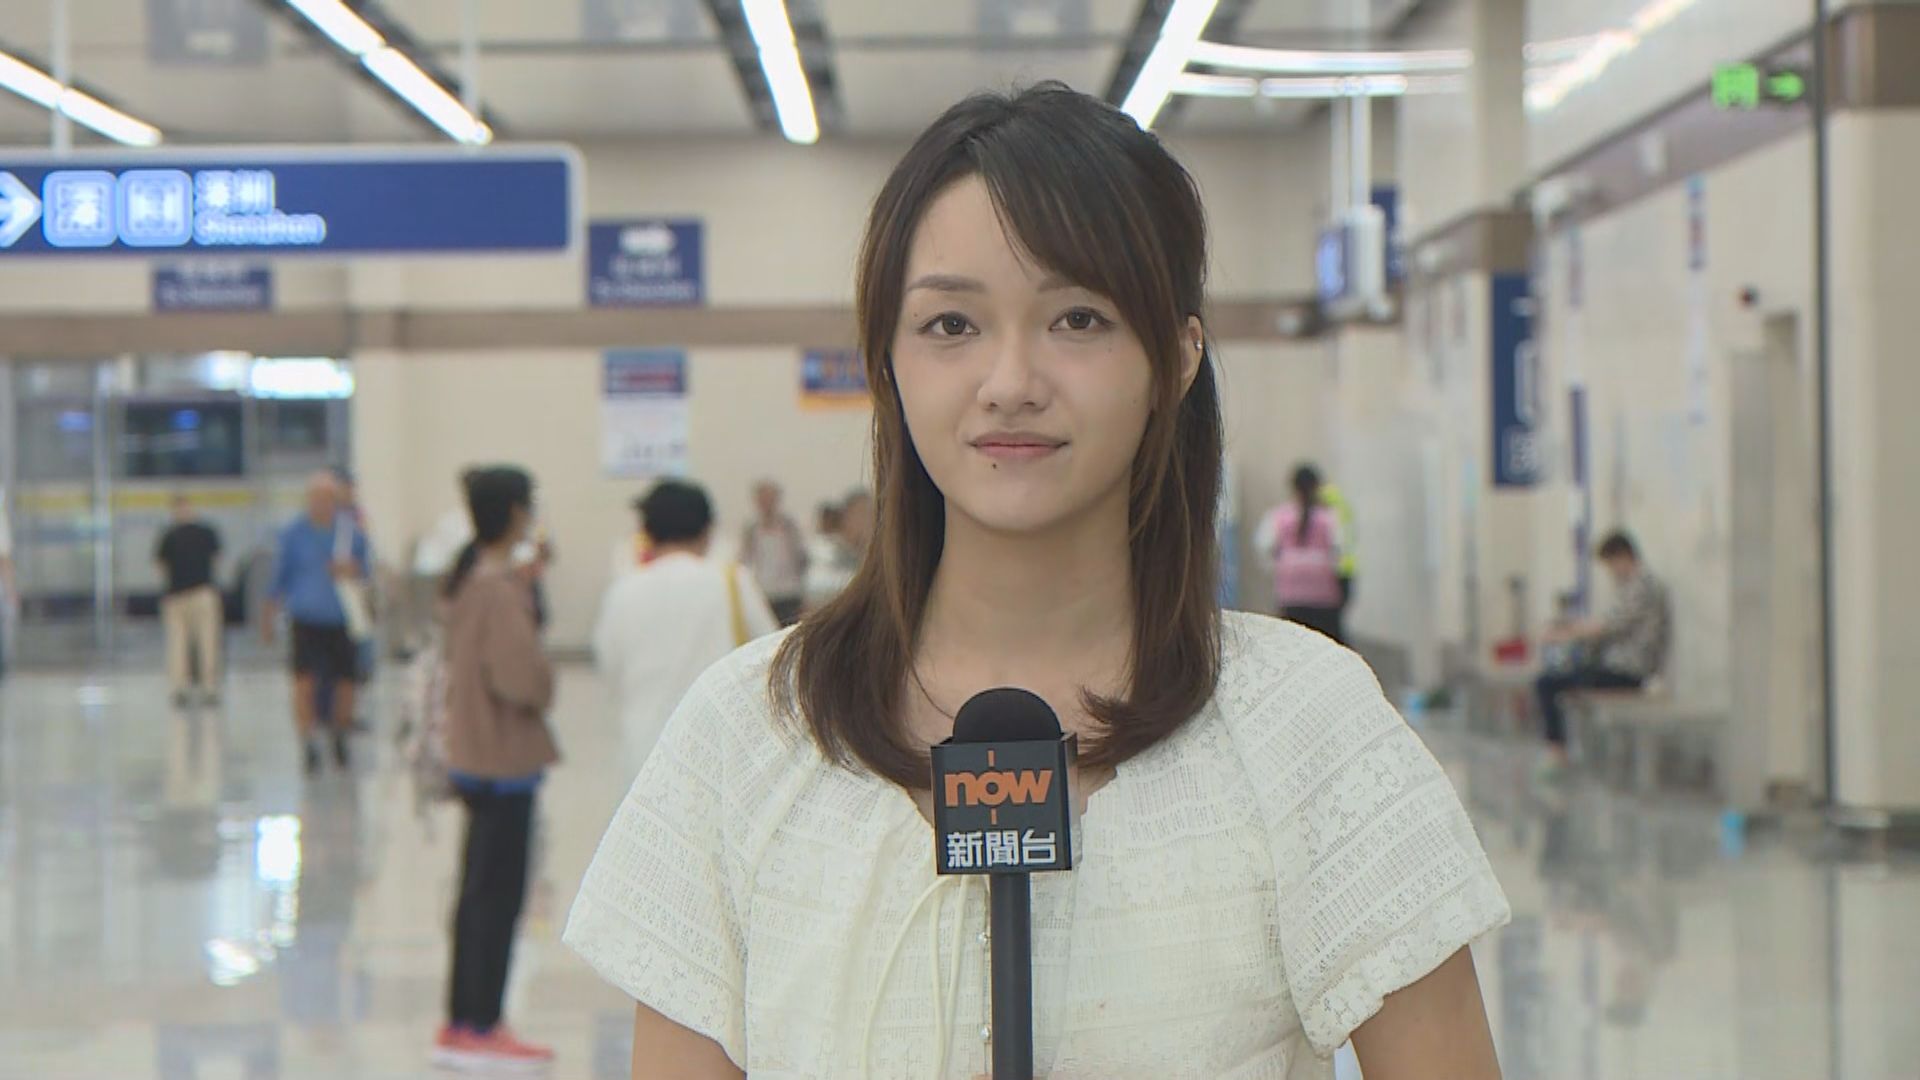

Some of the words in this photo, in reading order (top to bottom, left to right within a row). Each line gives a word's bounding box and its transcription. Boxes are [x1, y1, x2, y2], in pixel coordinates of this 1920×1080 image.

[944, 769, 1053, 807] now
[946, 829, 1056, 868] 新聞台
